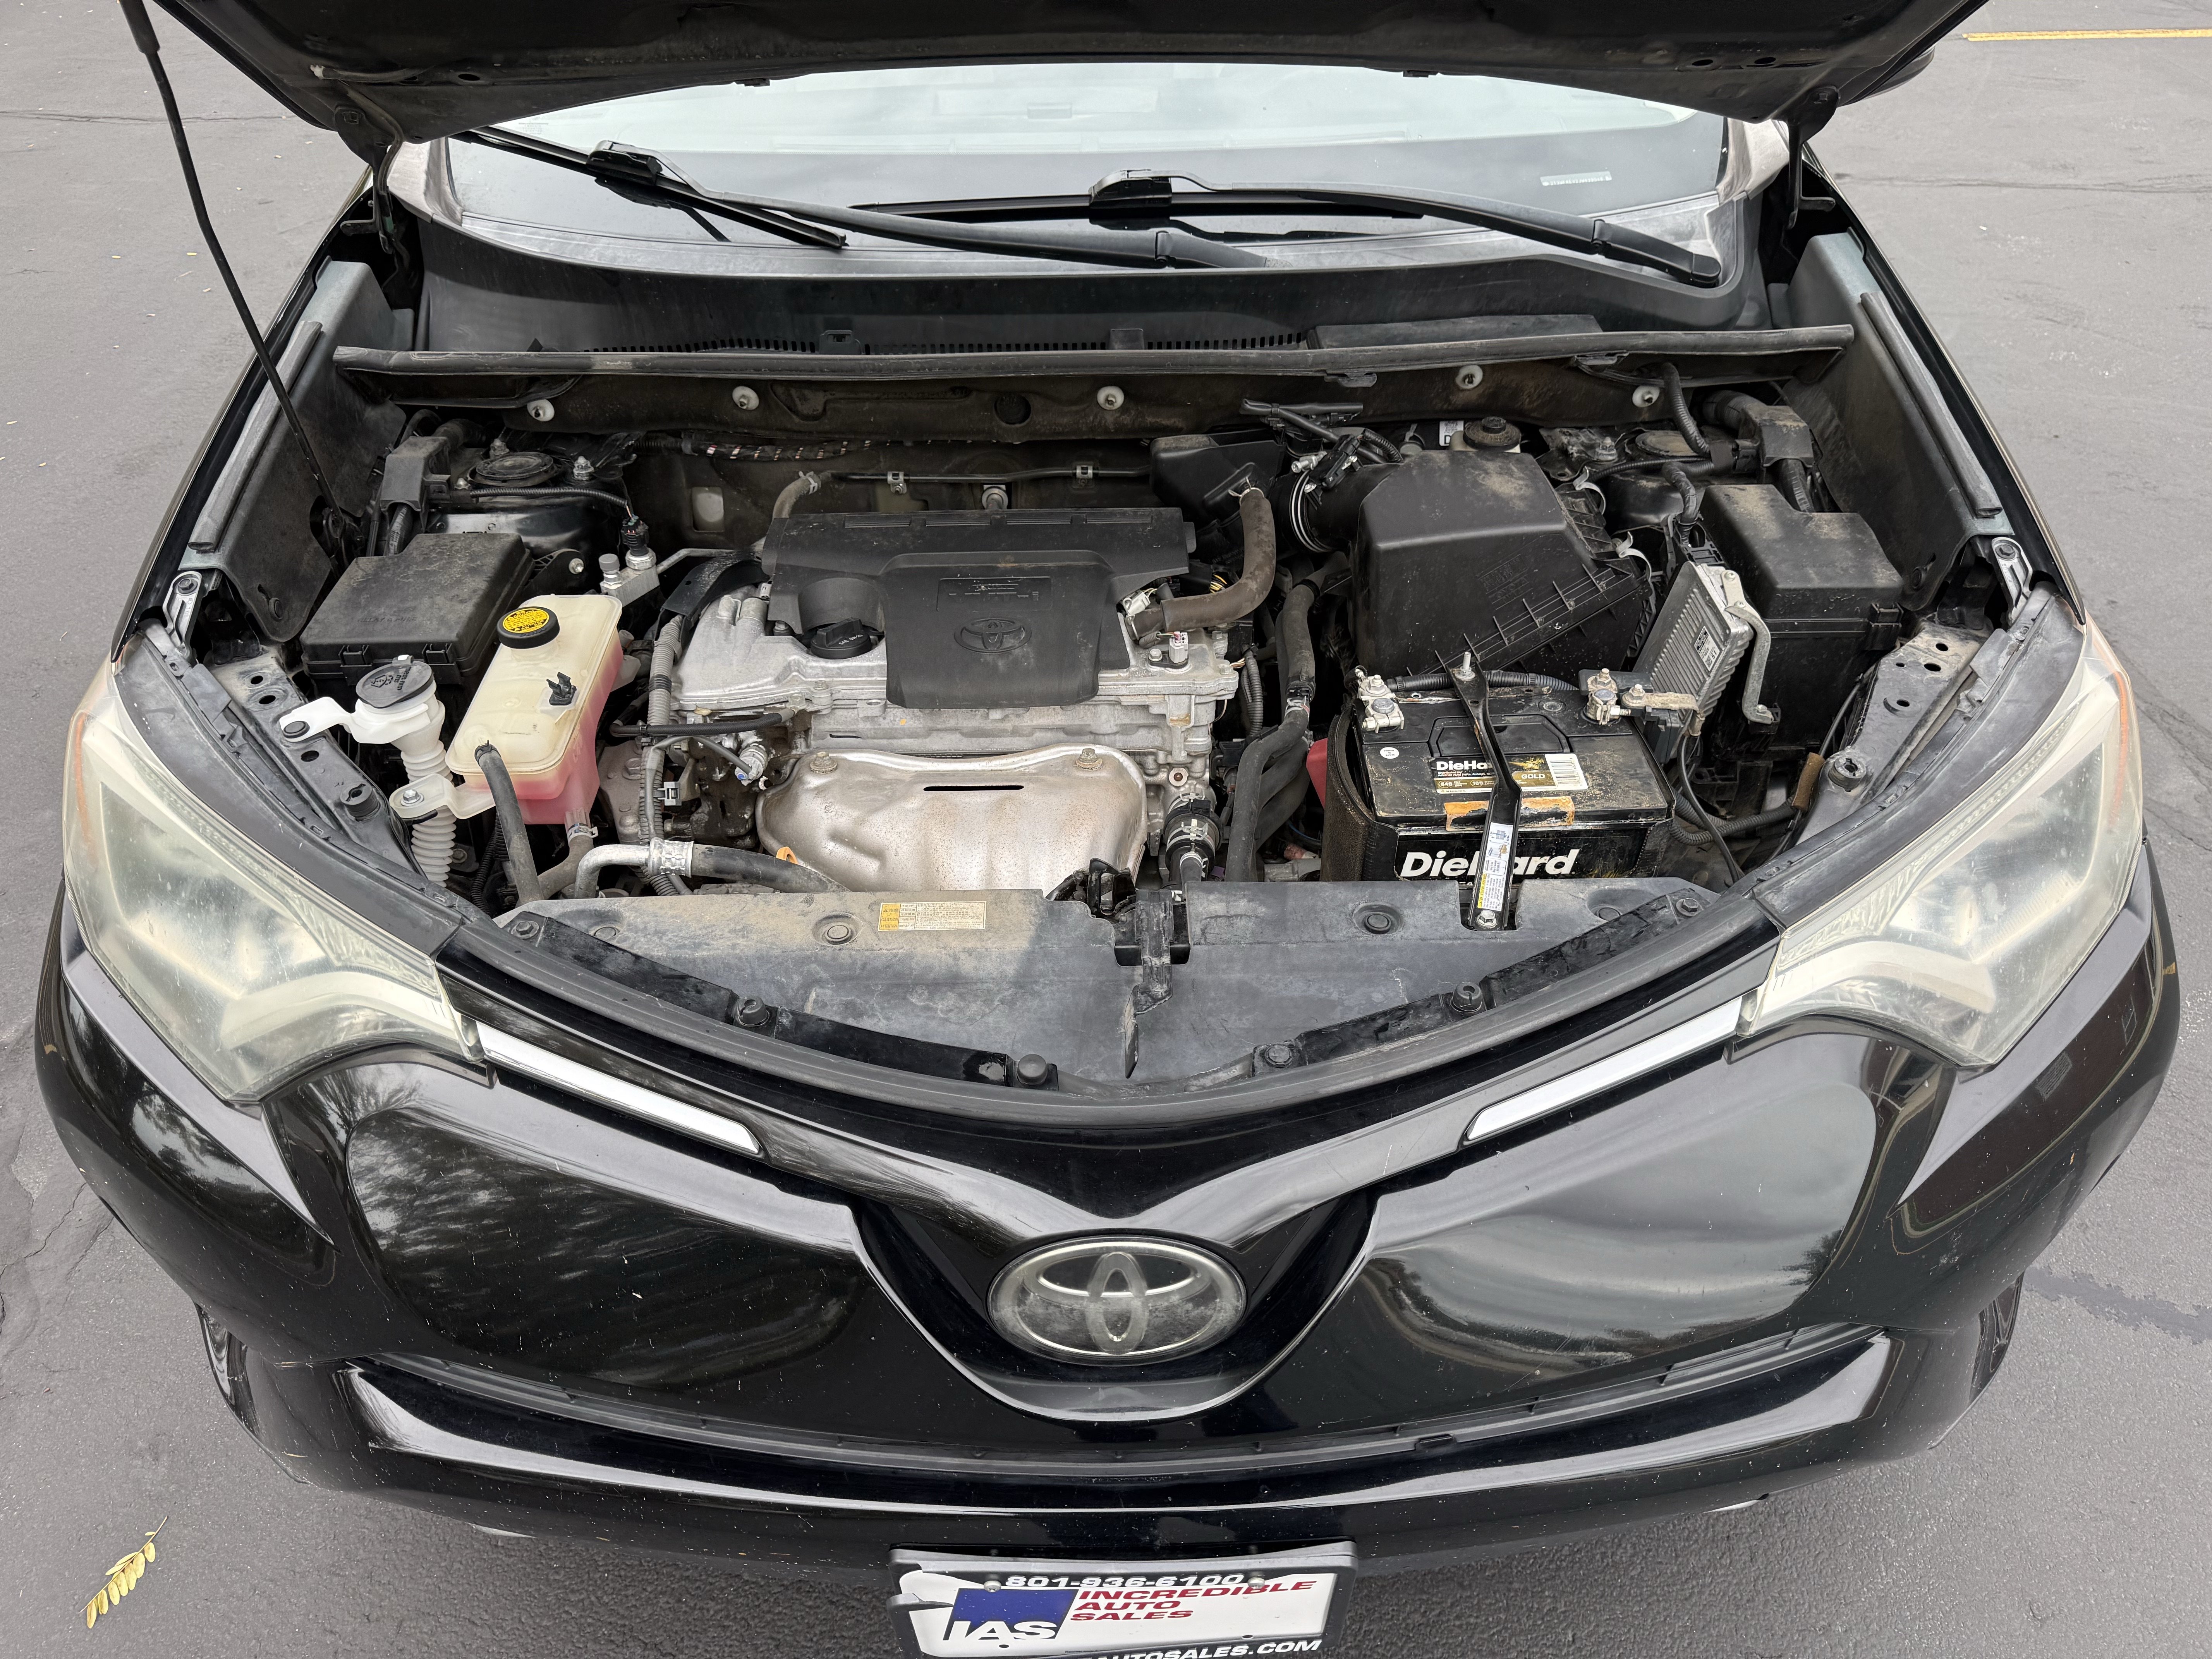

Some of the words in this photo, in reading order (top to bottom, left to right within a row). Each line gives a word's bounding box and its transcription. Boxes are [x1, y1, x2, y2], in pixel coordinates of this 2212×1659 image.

[1436, 760, 1488, 771] DieHa
[1005, 1573, 1244, 1587] 801-936-6100
[1079, 1581, 1317, 1599] INCREDIBLE
[1073, 1601, 1181, 1611] AUTO
[1070, 1610, 1194, 1621] SALES
[948, 1621, 1058, 1640] IAS
[1078, 1639, 1322, 1659] TOSALES.COM
